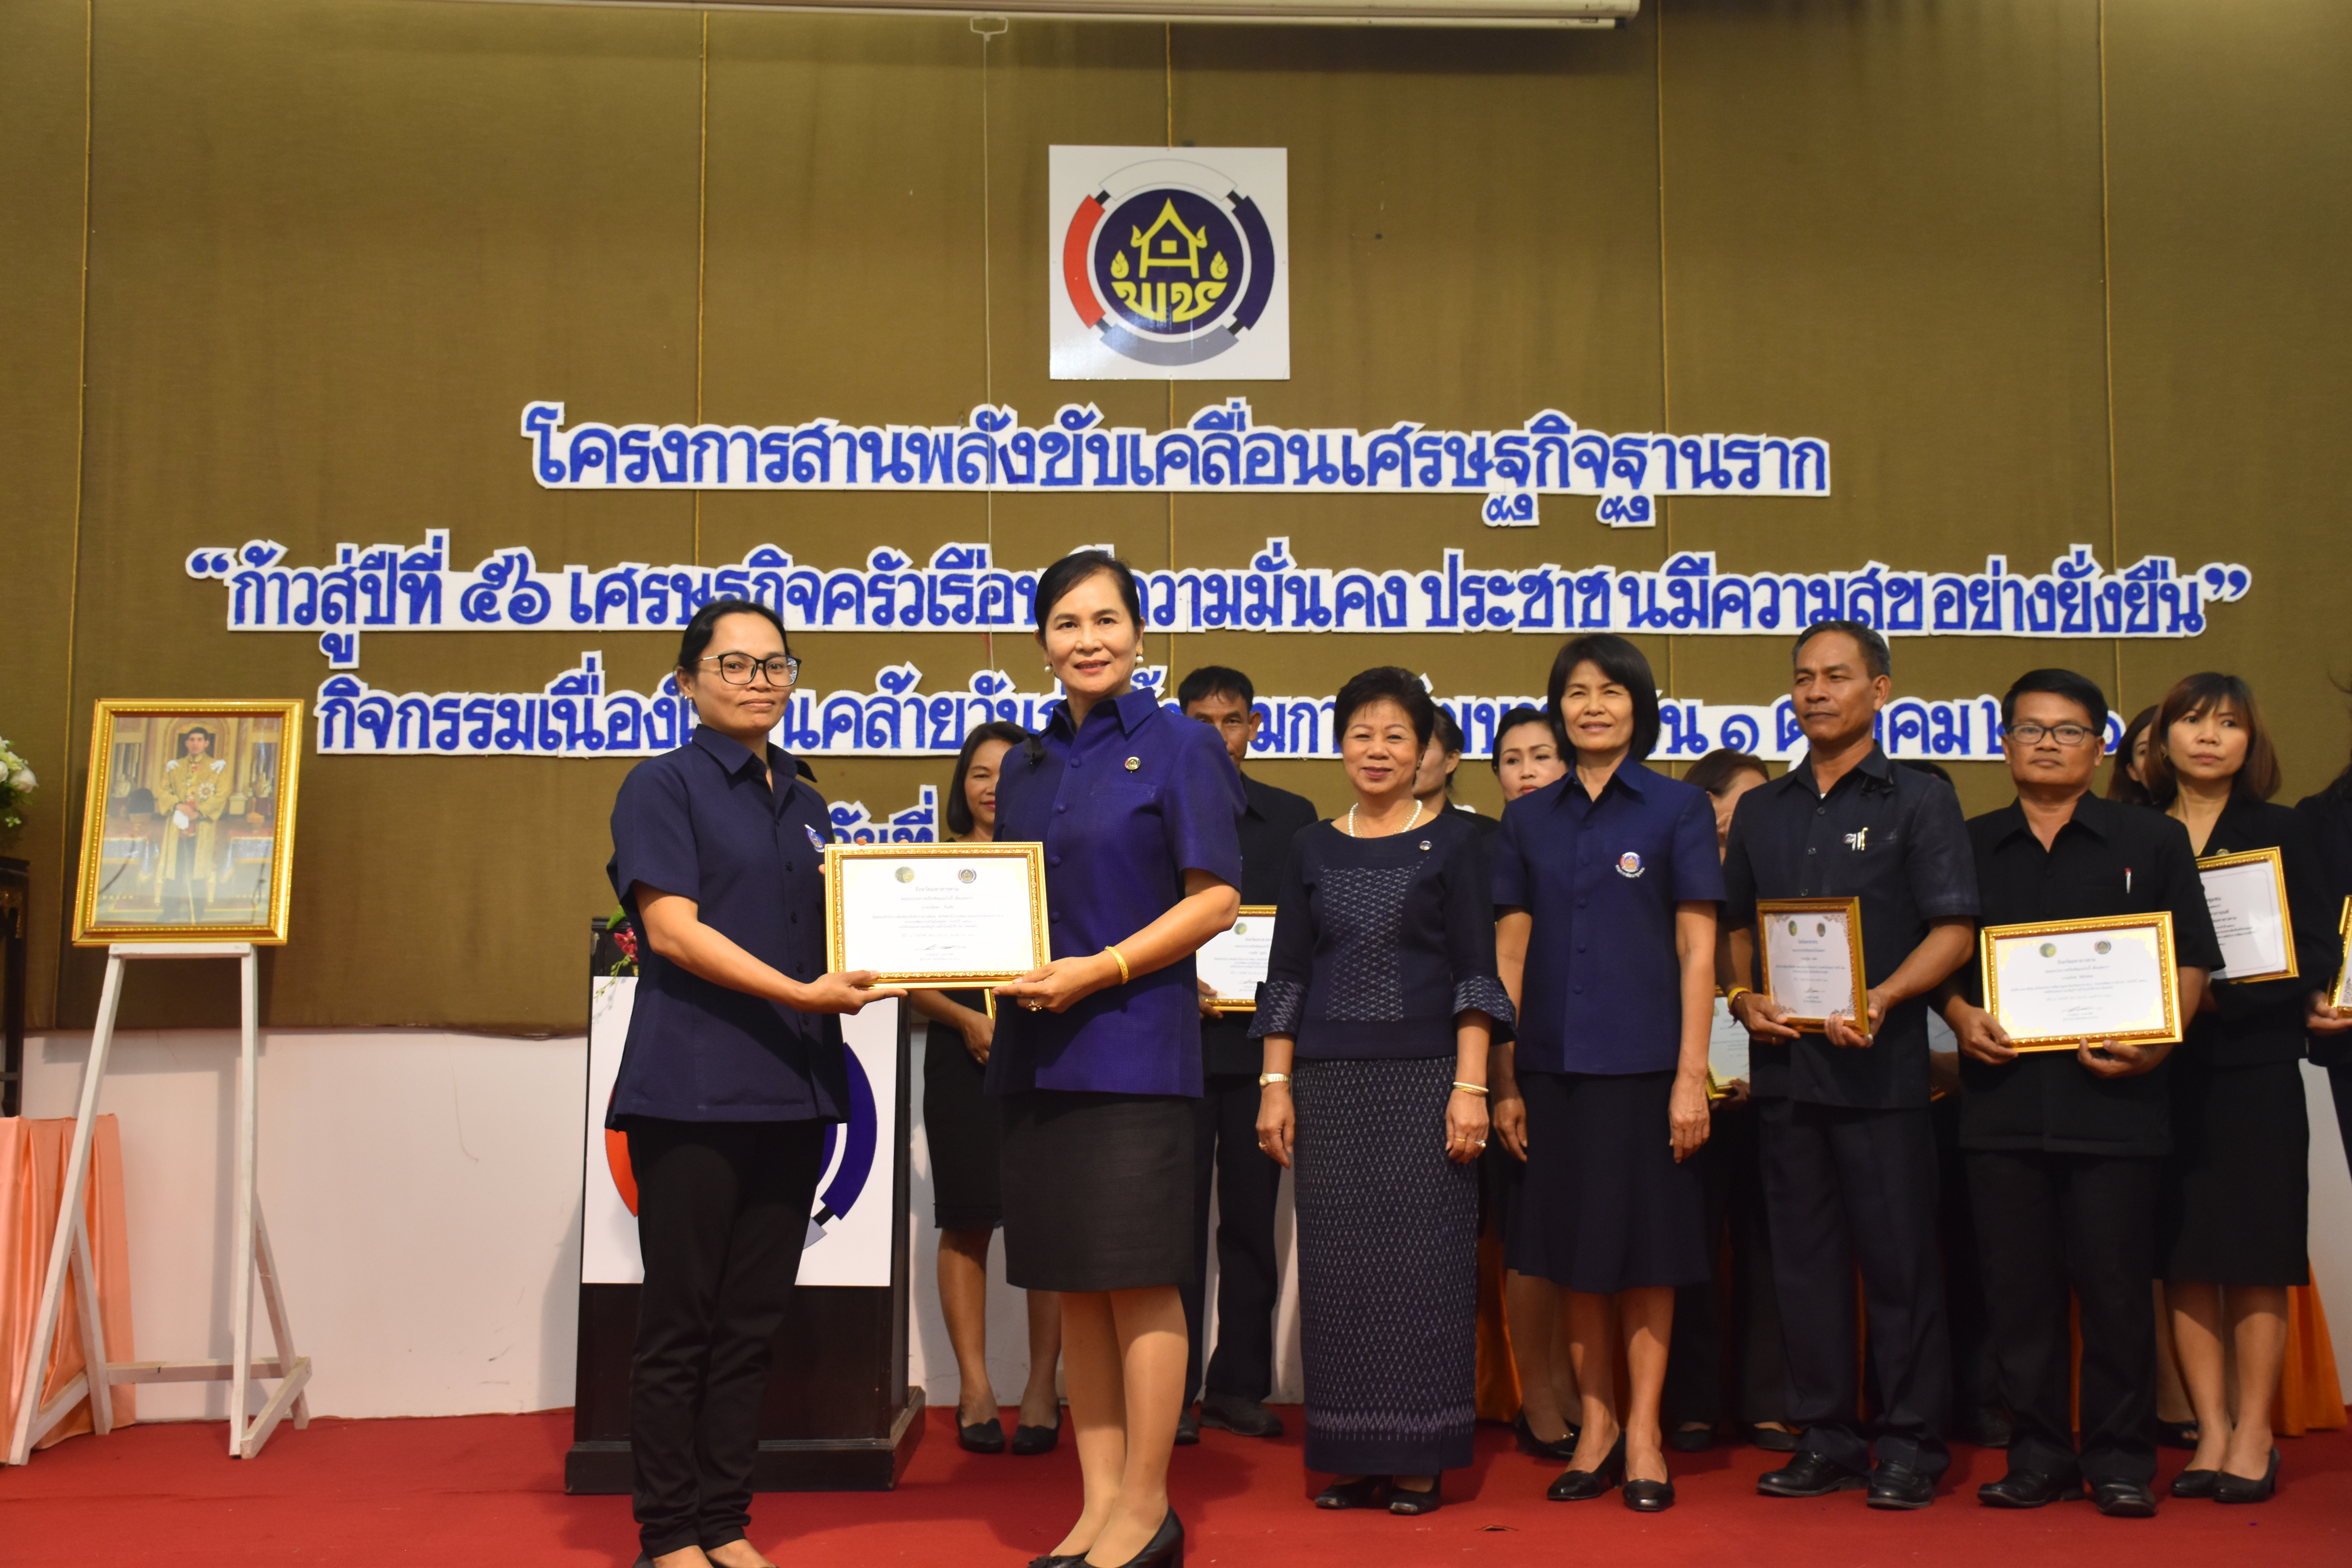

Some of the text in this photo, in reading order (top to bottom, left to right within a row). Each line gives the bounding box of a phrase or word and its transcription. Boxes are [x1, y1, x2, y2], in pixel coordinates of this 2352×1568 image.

[526, 403, 1826, 523] โครงการสานพลังขับเคลื่อนเศรษฐกิจฐานราก
[460, 553, 550, 624] ๕๖
